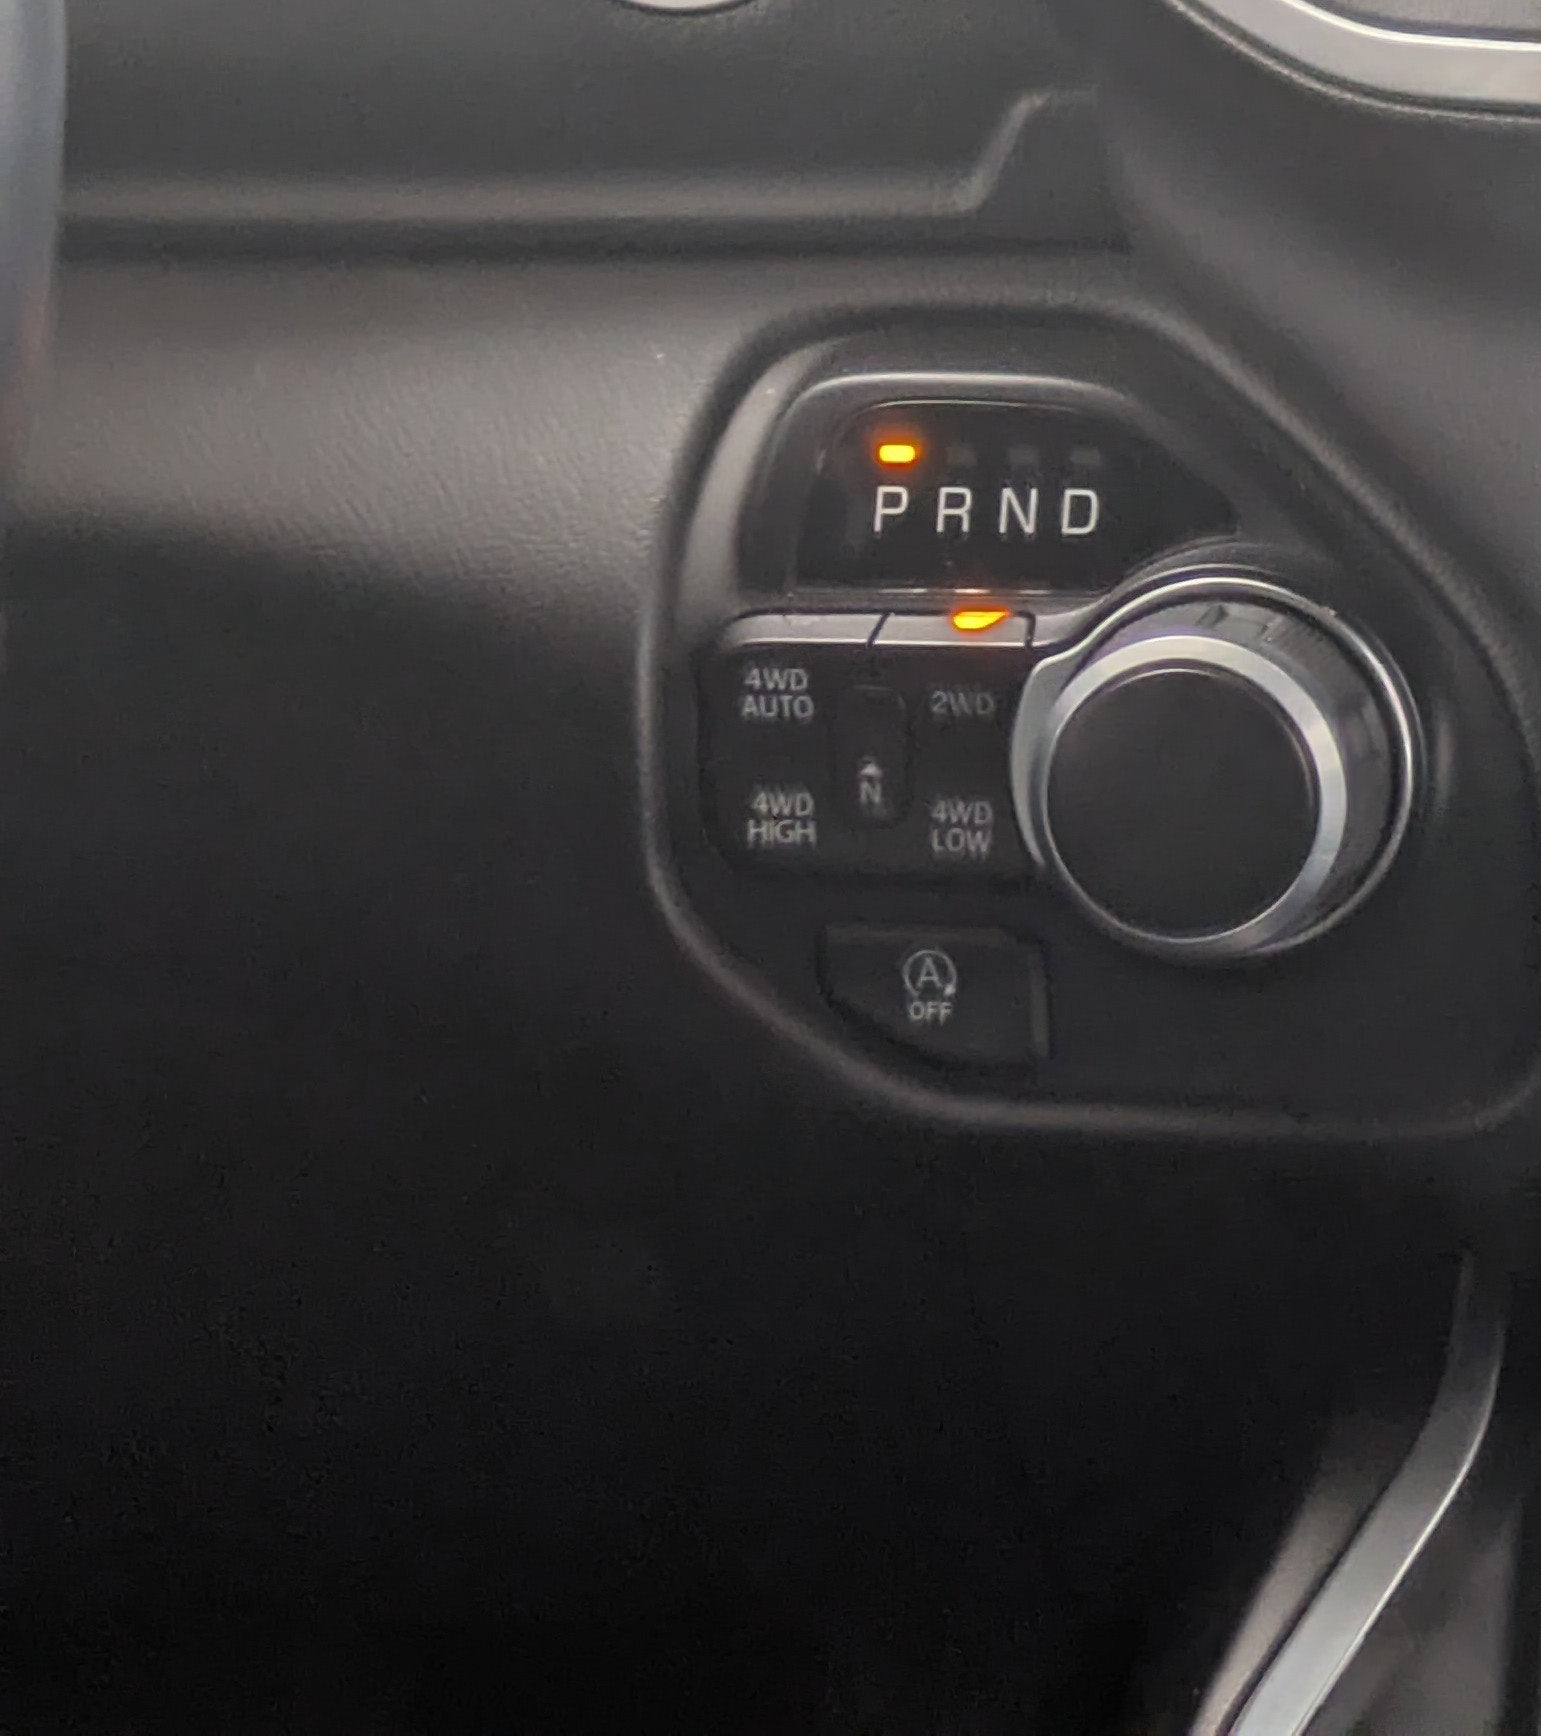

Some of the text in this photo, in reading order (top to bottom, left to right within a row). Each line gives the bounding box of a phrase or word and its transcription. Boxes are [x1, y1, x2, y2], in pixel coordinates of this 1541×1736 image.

[874, 486, 1100, 535] P R N D
[745, 668, 809, 691] 4WD
[742, 695, 815, 718] AUTO
[931, 690, 994, 716] 2WD
[753, 791, 815, 815] 4WD
[931, 800, 993, 824] 4WD
[748, 820, 817, 845] HIGH
[931, 827, 992, 854] LOW
[909, 1001, 952, 1024] OFF
